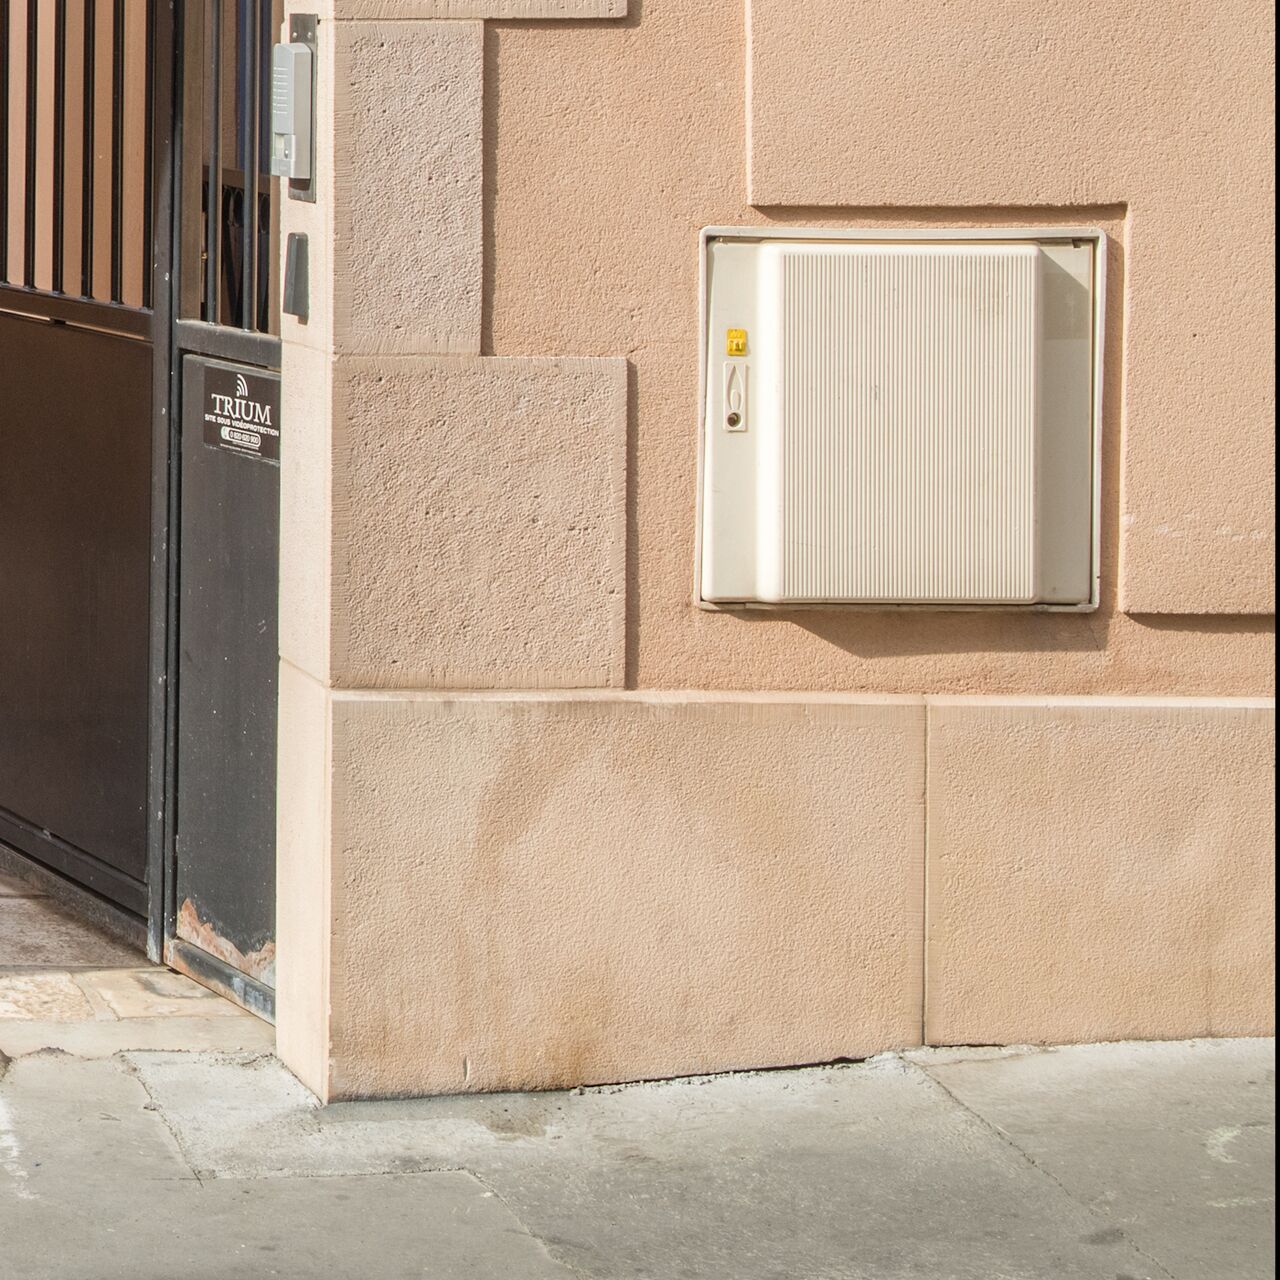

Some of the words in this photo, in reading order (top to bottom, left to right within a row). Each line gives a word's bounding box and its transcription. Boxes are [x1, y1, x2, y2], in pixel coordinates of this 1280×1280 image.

[205, 414, 216, 422] SITE
[217, 417, 230, 425] SOUS
[211, 393, 272, 426] TRIUM
